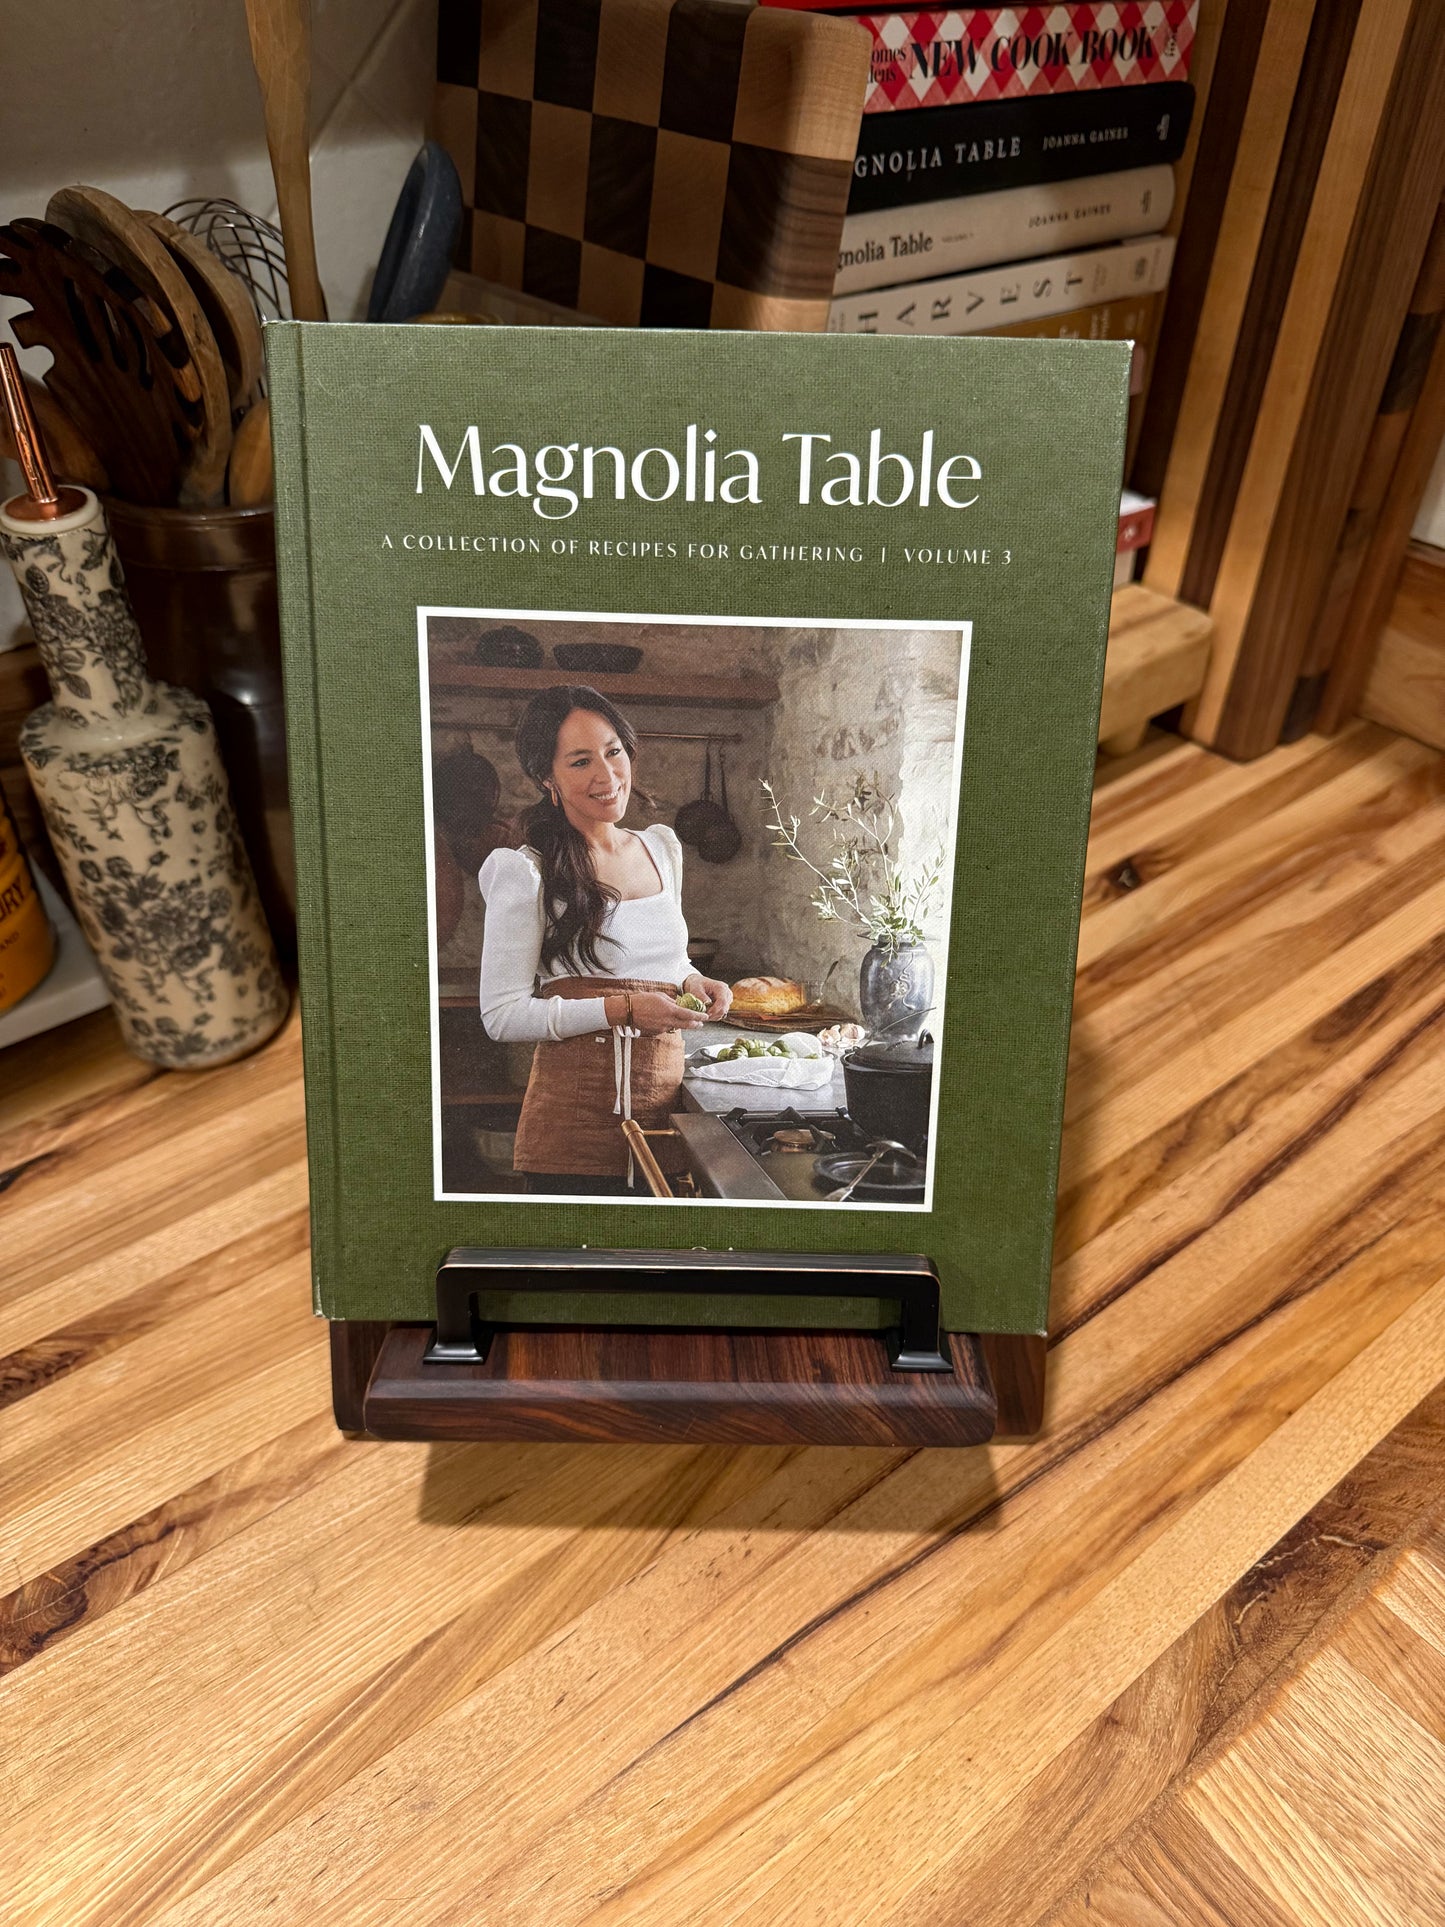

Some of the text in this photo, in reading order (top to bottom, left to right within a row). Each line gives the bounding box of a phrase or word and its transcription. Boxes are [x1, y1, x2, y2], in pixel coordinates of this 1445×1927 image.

[909, 38, 984, 80] NEW
[991, 31, 1073, 73] COOK
[1080, 25, 1158, 64] BOOK
[955, 137, 1022, 164] TABLE
[1042, 126, 1129, 150] JOANNA GAINES
[889, 232, 933, 258] Table
[416, 424, 982, 520] Magnolia Table
[381, 534, 393, 549] A
[403, 535, 540, 553] COLLECTION
[551, 540, 579, 555] OF
[590, 541, 677, 558] RECIPES
[688, 543, 729, 559] FOR
[740, 546, 863, 563] GATHERING
[904, 548, 991, 564] VOLUME
[1001, 550, 1011, 565] 3
